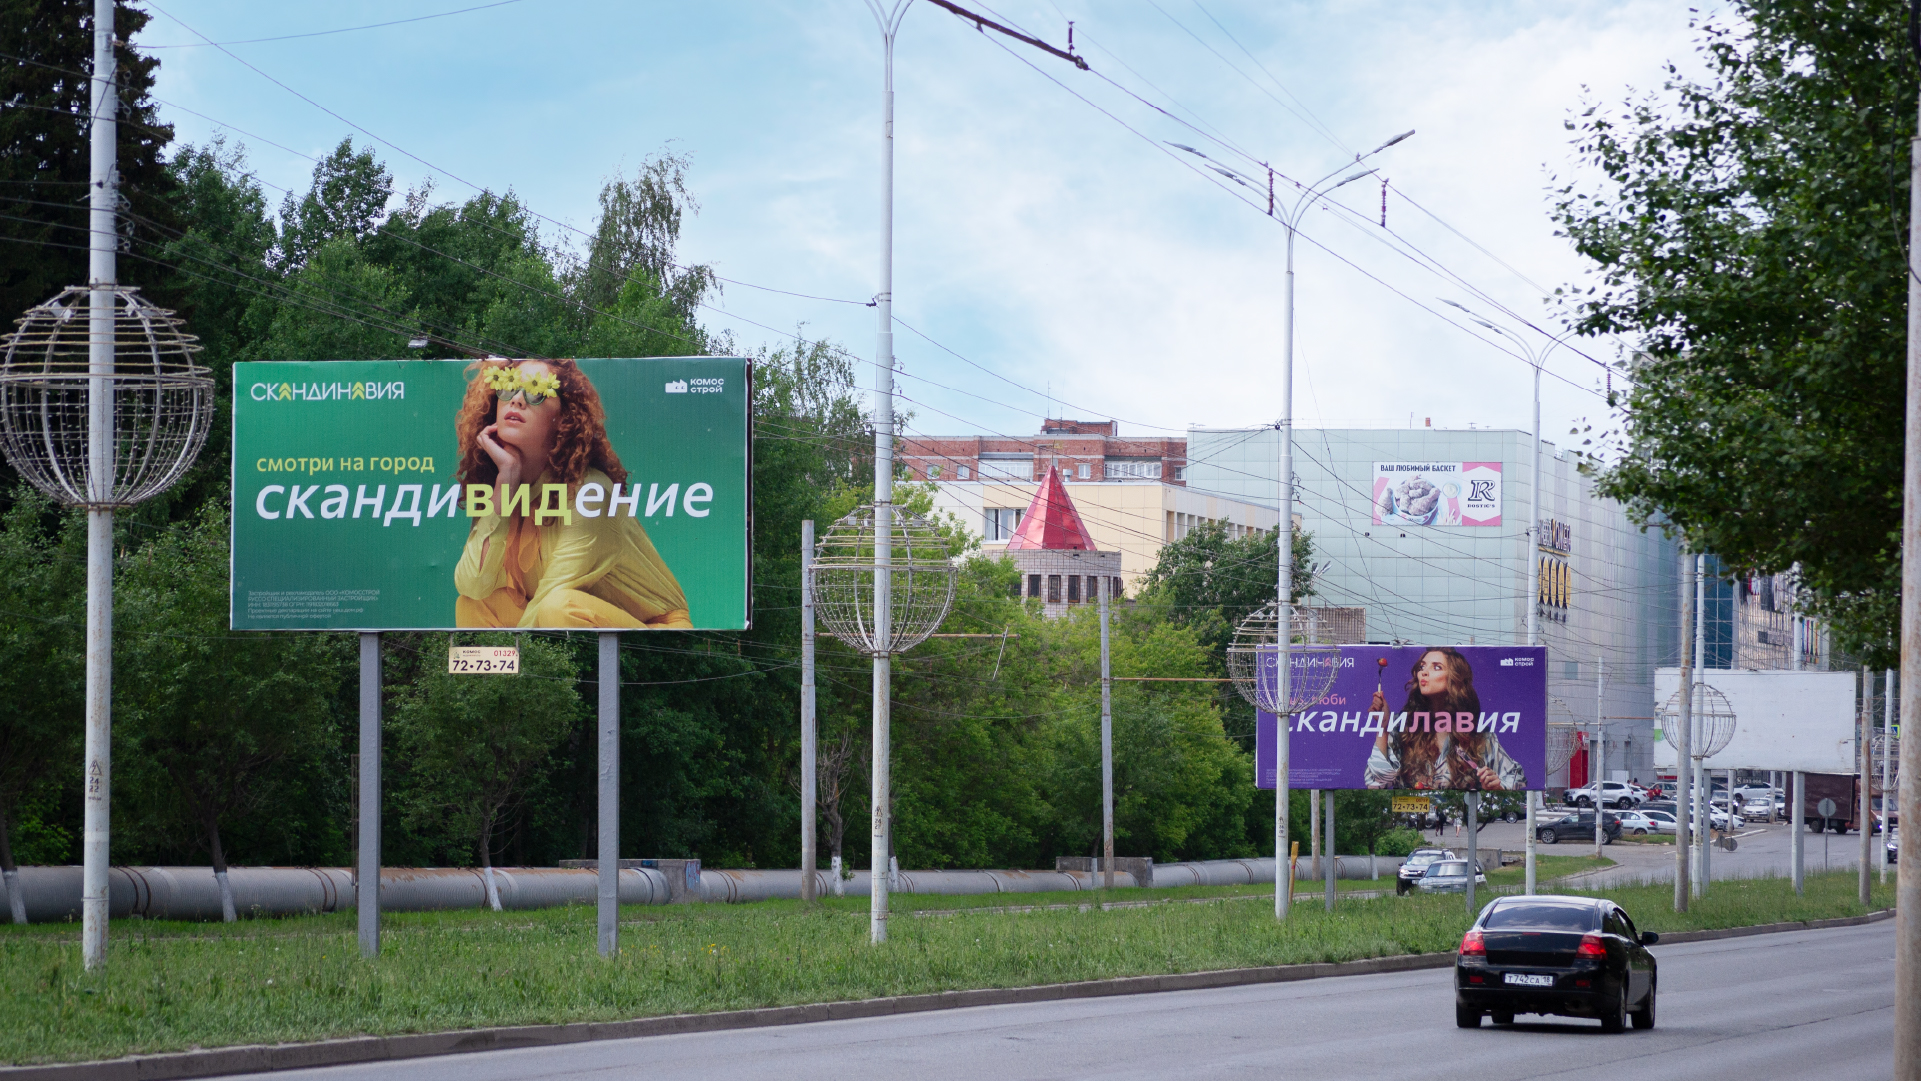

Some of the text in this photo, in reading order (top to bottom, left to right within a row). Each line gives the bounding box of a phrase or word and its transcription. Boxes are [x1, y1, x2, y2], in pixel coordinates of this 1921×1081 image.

[250, 382, 405, 400] СКАНДИНАВИЯ
[256, 457, 434, 475] смотри на город
[1380, 464, 1394, 472] ВАШ
[1396, 464, 1431, 472] ЛЮБИМЫЙ
[256, 482, 714, 528] скандивидение
[1266, 656, 1354, 668] СНДИНАВИЯ
